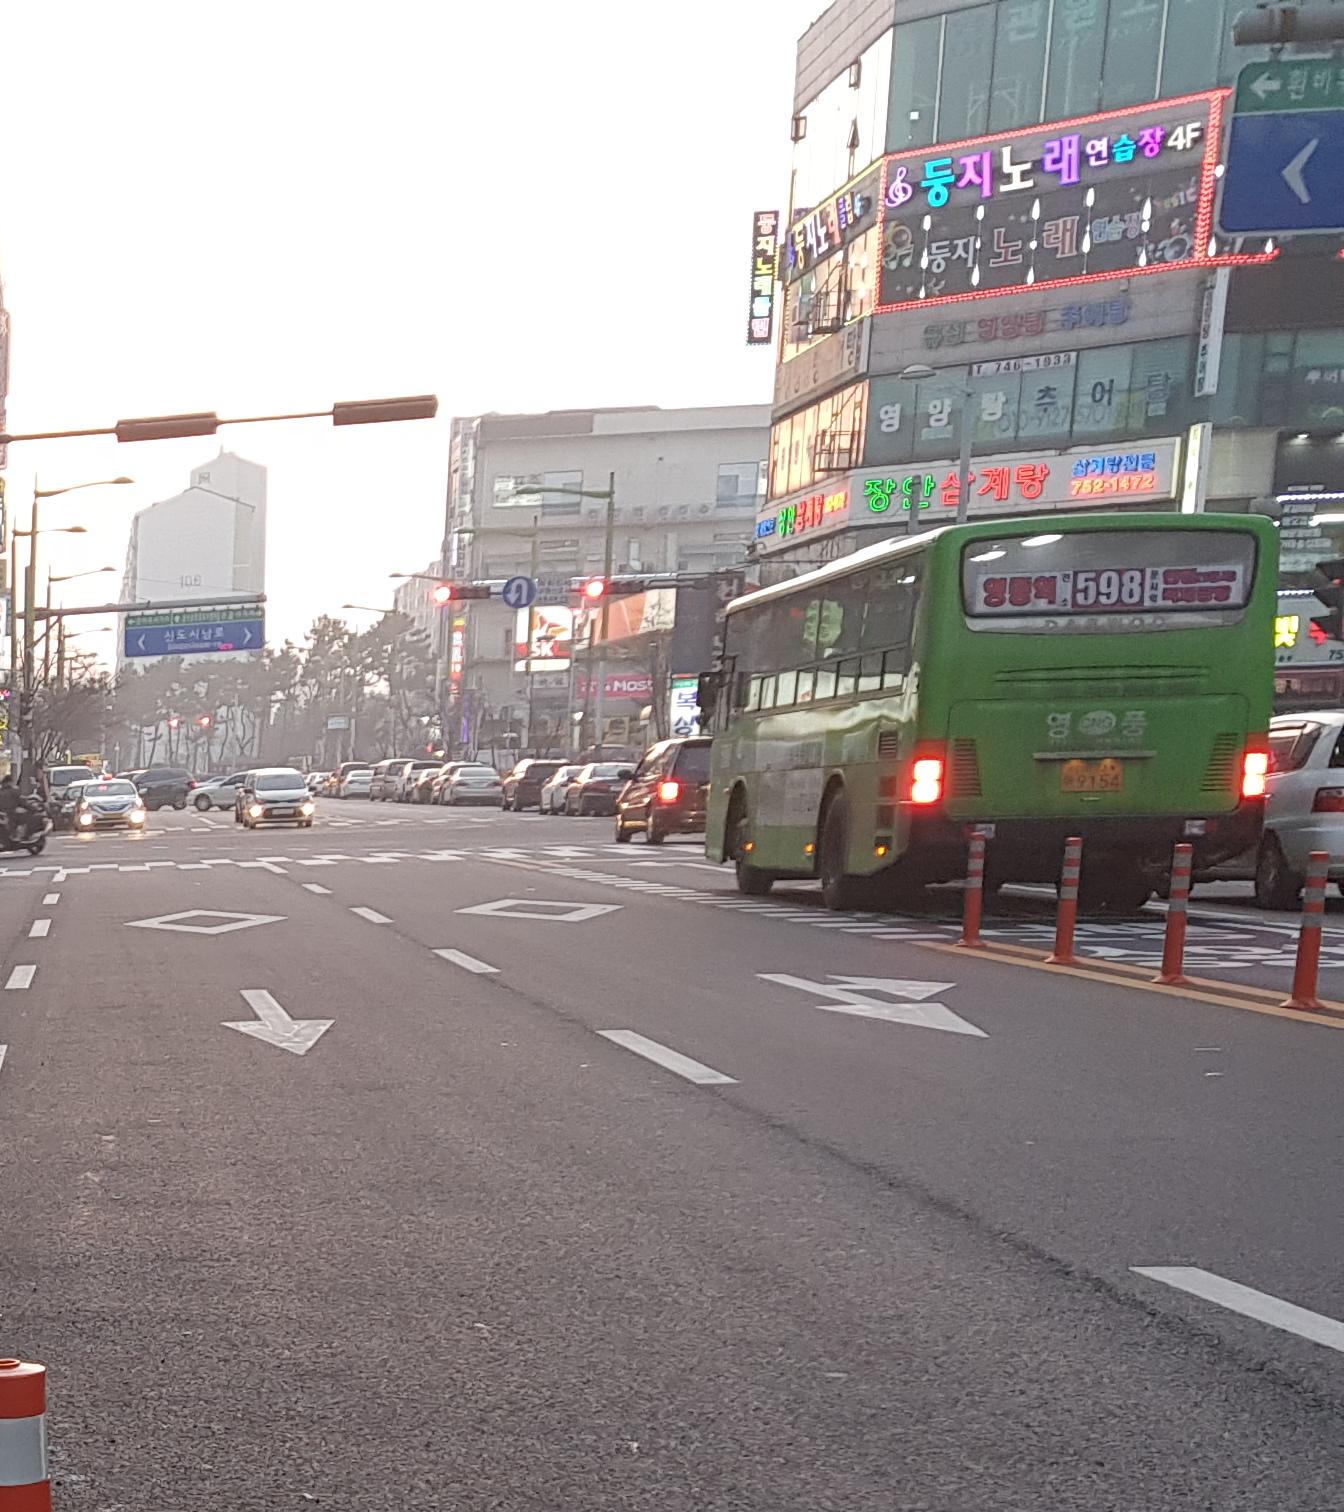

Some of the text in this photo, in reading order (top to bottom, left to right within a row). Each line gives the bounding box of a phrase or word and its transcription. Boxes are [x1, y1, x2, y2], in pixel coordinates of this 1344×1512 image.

[1168, 121, 1202, 150] 4F
[1070, 473, 1156, 497] 752-1472
[1075, 570, 1142, 605] 598
[530, 640, 554, 657] SK
